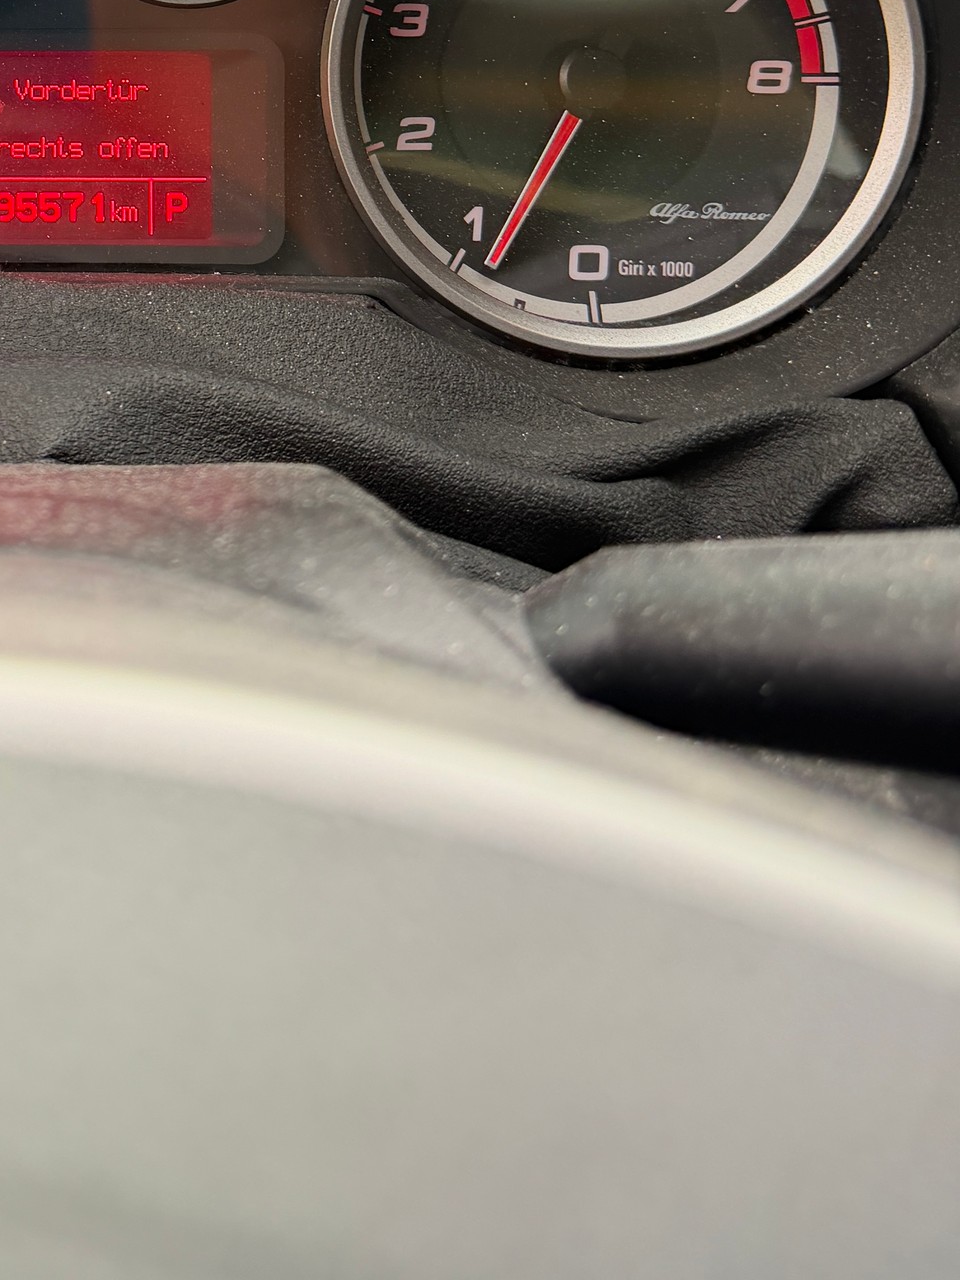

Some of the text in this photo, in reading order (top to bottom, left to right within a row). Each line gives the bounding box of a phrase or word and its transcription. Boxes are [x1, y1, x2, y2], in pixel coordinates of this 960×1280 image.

[389, 3, 429, 37] 3
[13, 79, 149, 102] Vordertür
[747, 60, 792, 94] 8
[98, 138, 170, 159] offen
[396, 117, 436, 151] 2
[165, 192, 189, 222] P
[649, 202, 772, 225] Alfa Romeo
[463, 207, 483, 241] 1
[568, 244, 609, 281] 0
[618, 259, 643, 276] Giri
[660, 261, 694, 277] 1000
